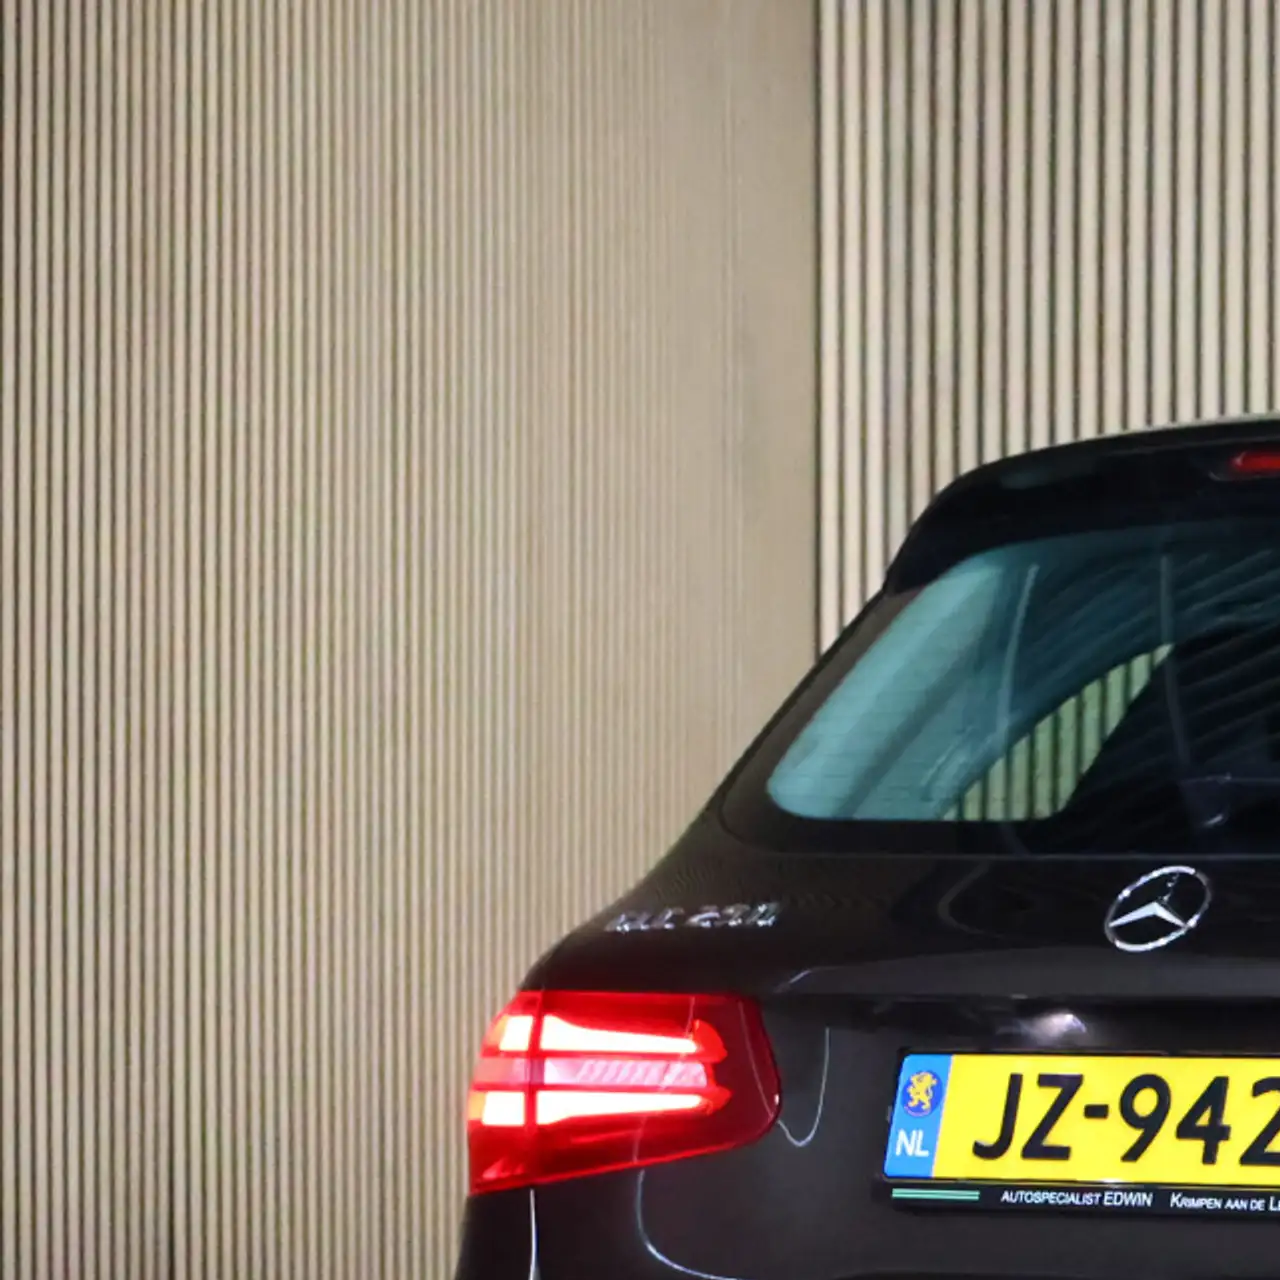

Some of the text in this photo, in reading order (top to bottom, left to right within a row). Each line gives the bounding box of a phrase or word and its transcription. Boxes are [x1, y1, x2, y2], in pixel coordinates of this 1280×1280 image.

[895, 1129, 929, 1157] NL
[1001, 1191, 1102, 1206] AUTOSPECIALIST
[1103, 1192, 1153, 1207] EDWIN
